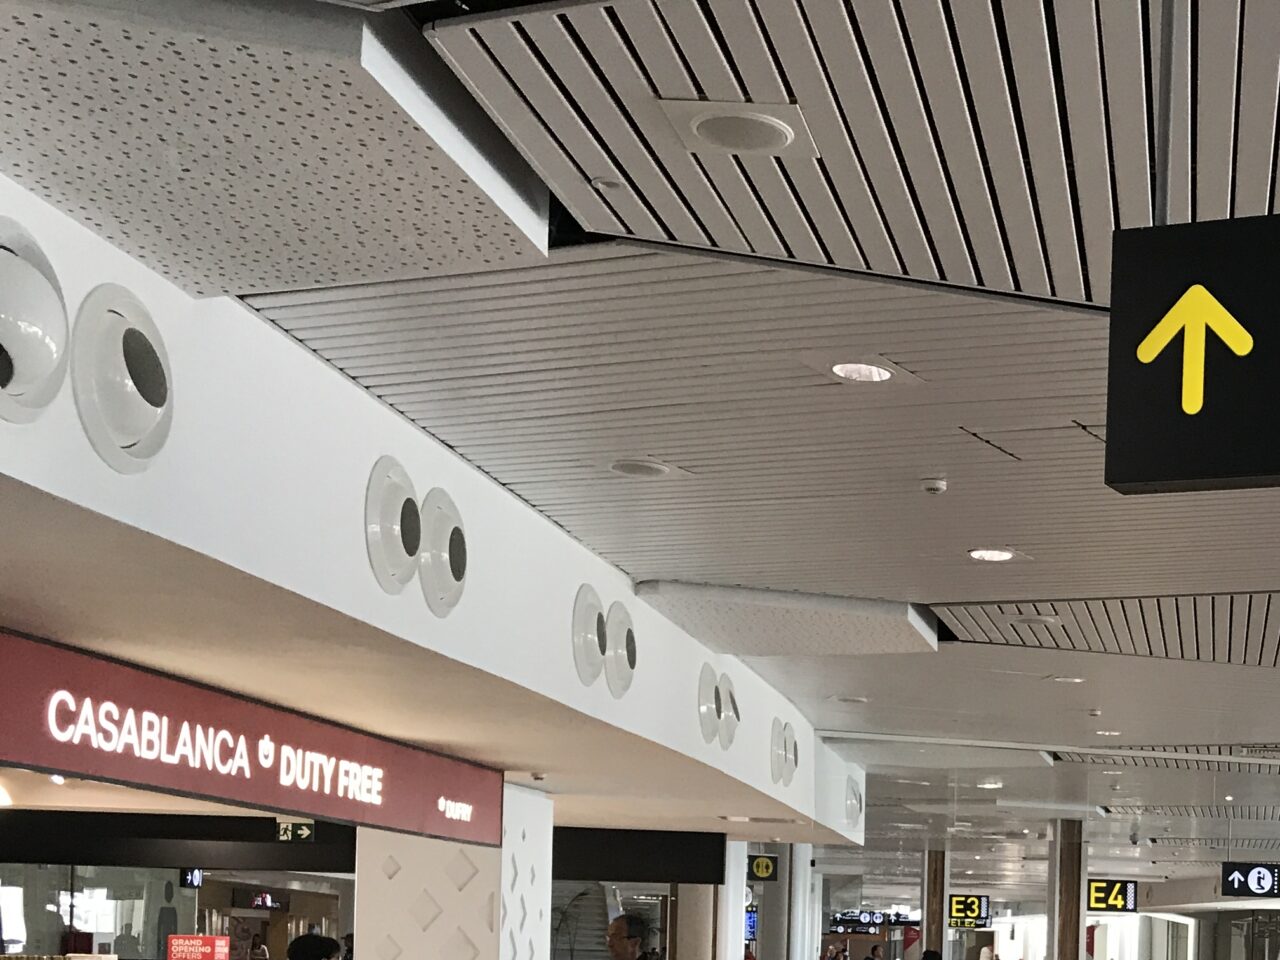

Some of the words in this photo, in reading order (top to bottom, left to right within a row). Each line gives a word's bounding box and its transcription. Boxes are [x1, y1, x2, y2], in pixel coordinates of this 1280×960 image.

[48, 689, 251, 779] CASABLANCA
[280, 744, 337, 795] DUTY
[338, 759, 384, 806] FREE
[1090, 882, 1125, 909] E4
[951, 896, 980, 918] E3
[171, 938, 203, 946] GRAND
[171, 945, 212, 953] OPENING
[171, 952, 202, 960] OFFERS
